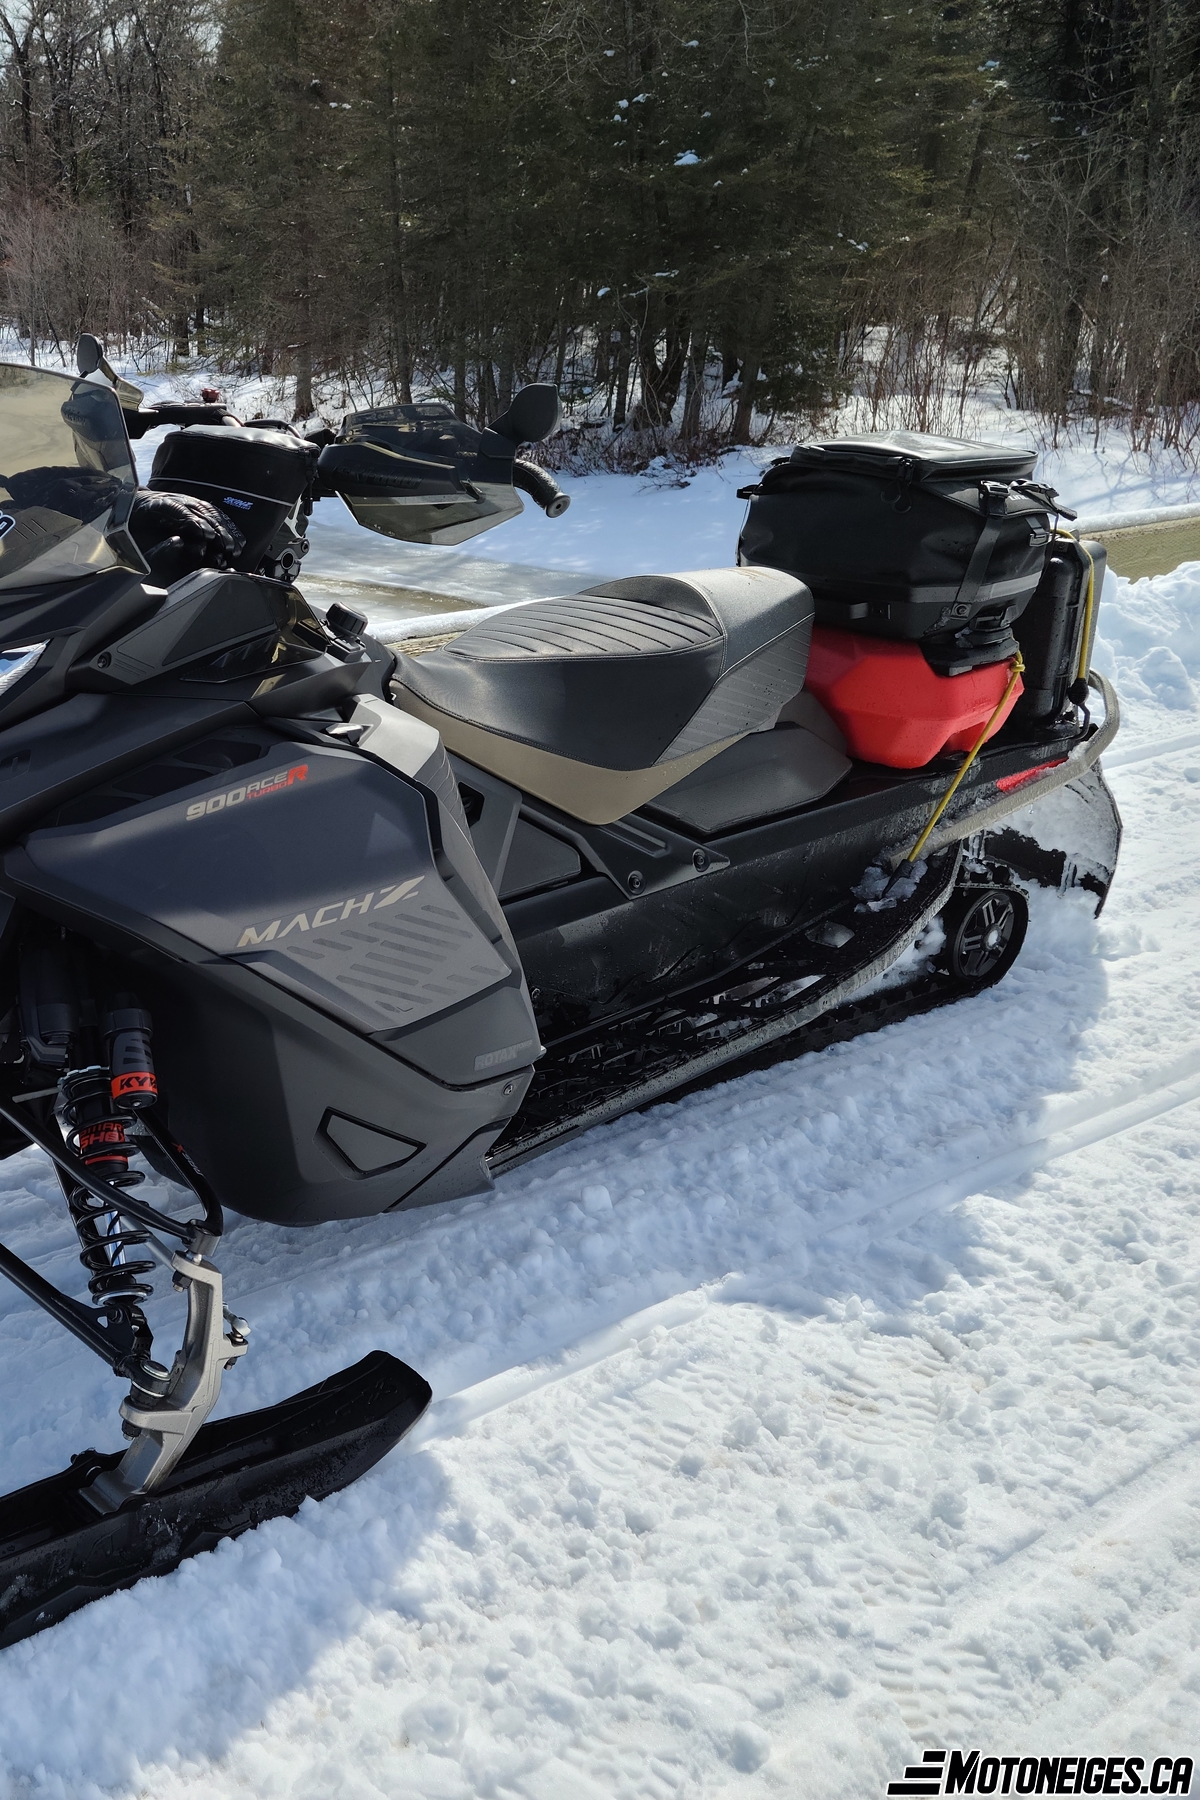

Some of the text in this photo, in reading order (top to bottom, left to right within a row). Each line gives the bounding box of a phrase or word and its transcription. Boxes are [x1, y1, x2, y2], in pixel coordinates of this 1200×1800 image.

[186, 786, 247, 821] 900
[246, 771, 288, 794] ACE
[247, 781, 288, 799] TURBO
